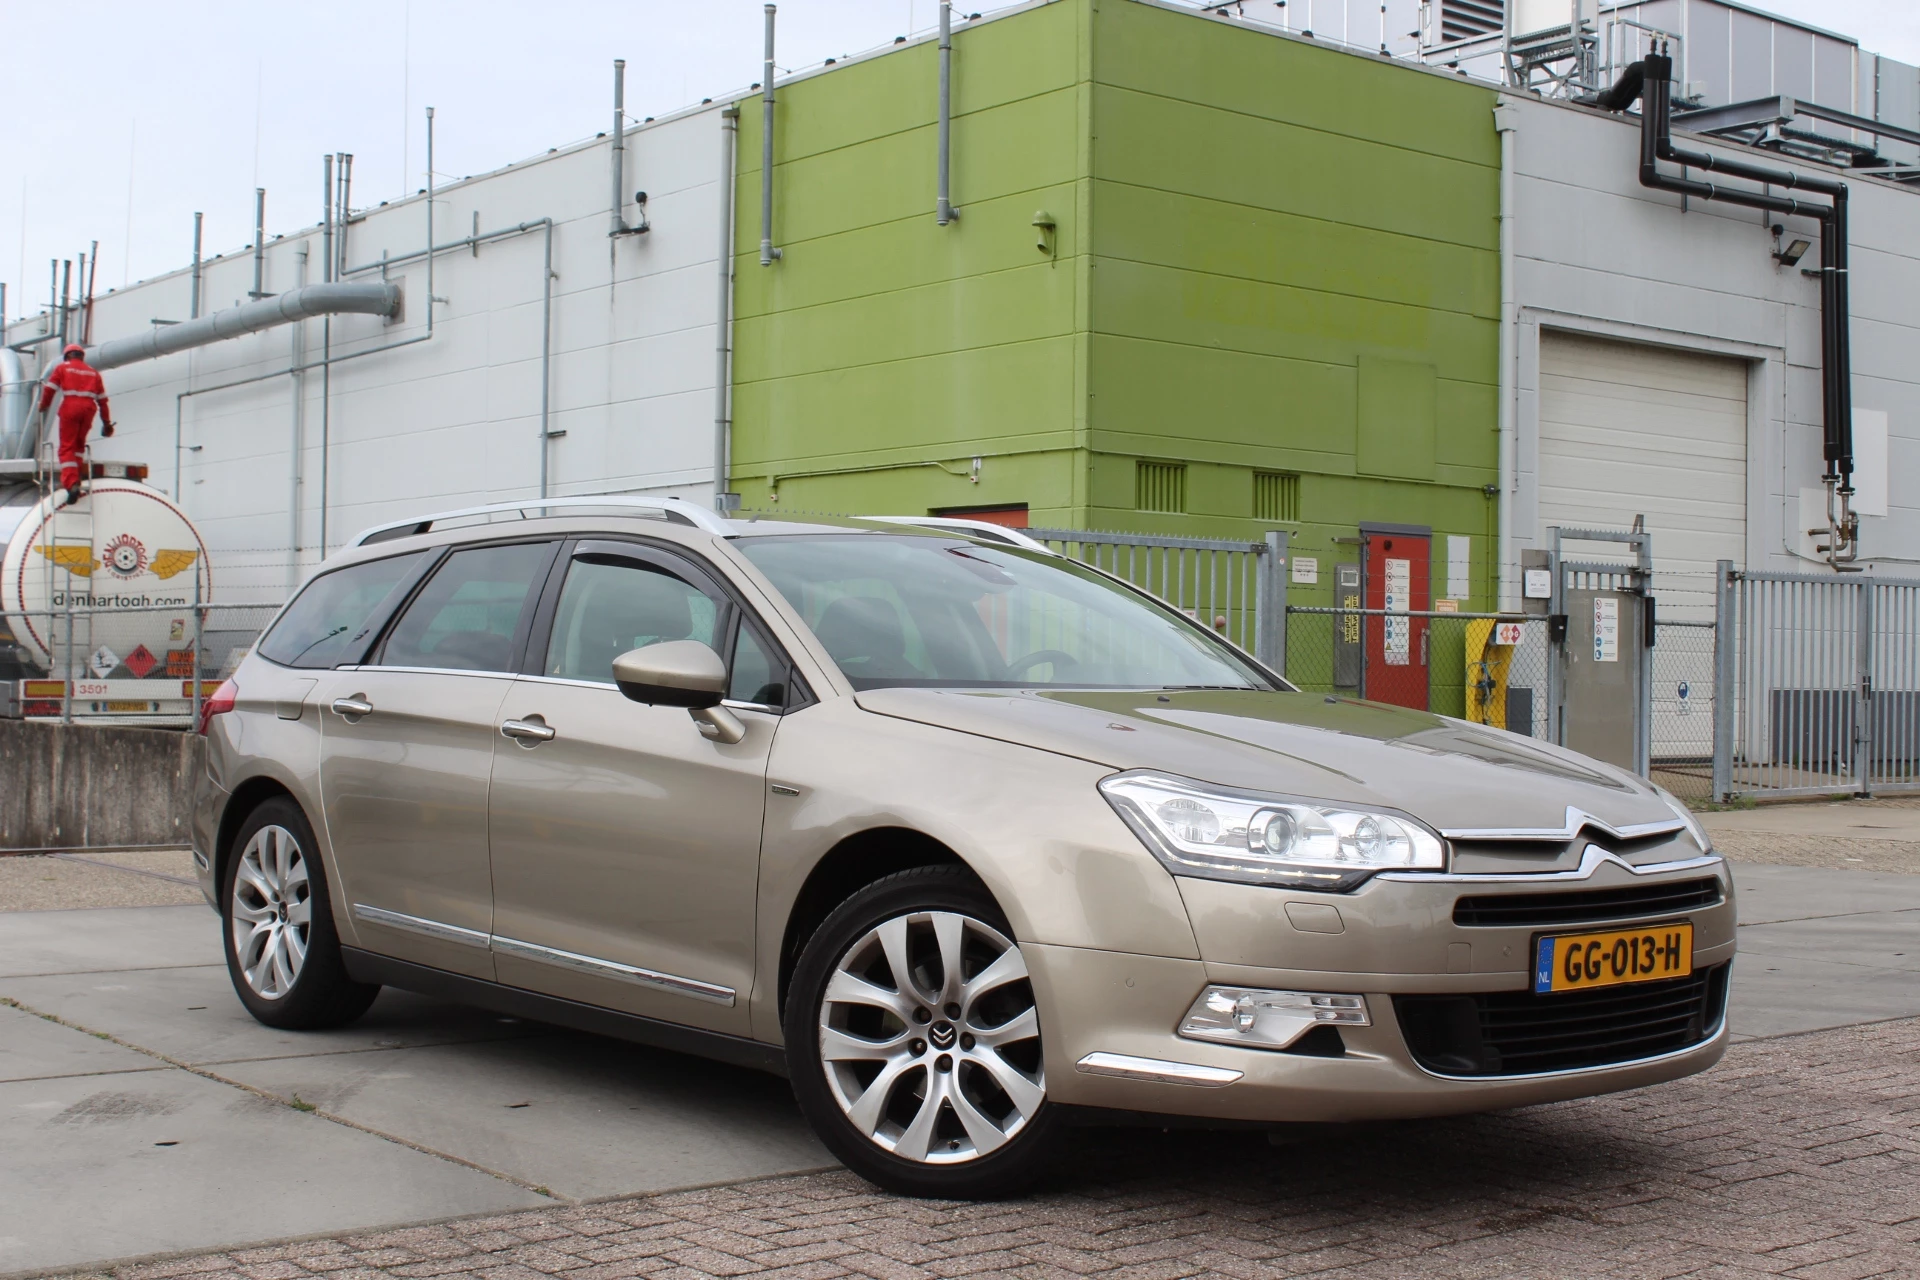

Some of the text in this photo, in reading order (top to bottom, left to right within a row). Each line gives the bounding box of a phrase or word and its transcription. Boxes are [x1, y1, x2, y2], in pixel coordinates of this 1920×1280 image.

[53, 593, 186, 607] dnhartogh.com
[79, 684, 108, 695] 3501
[1564, 932, 1682, 983] GG-013-H
[1538, 971, 1551, 984] NL
